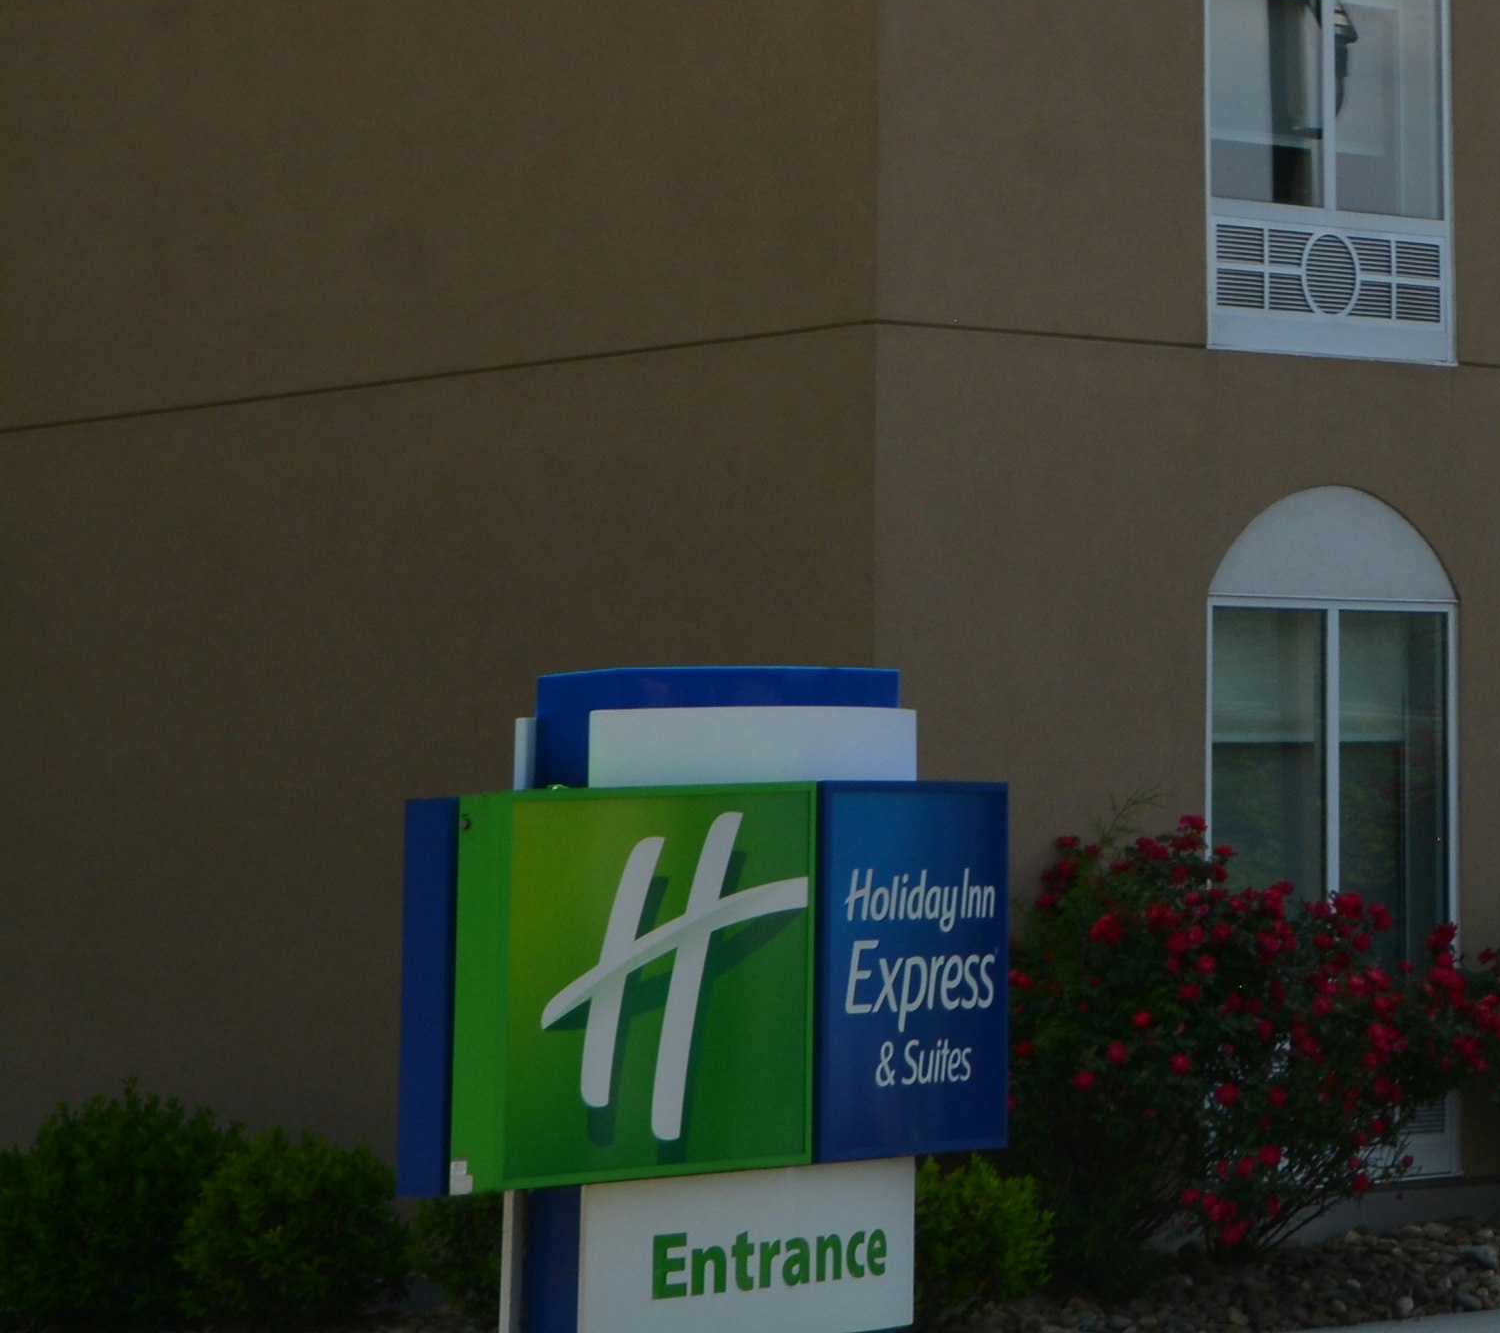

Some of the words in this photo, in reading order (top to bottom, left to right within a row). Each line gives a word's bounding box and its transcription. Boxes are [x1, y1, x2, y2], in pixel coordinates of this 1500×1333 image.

[844, 868, 958, 933] Holiday
[959, 867, 996, 919] Inn
[844, 939, 996, 1033] Express
[875, 1040, 896, 1087] &
[901, 1038, 972, 1085] Suites
[651, 1227, 888, 1301] Entrance
